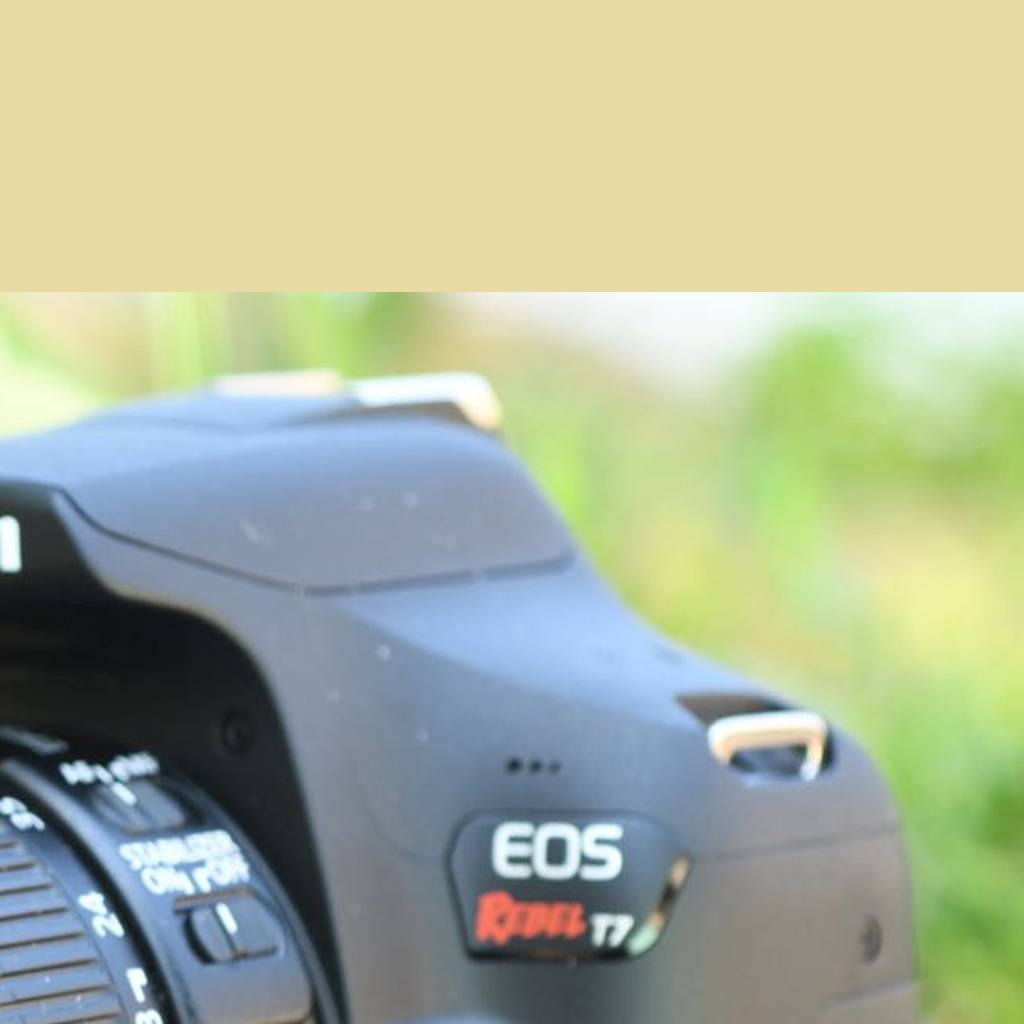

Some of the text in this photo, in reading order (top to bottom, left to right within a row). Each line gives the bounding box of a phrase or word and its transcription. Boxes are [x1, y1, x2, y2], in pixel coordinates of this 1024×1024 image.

[492, 820, 624, 881] EOS
[78, 891, 124, 938] 24
[591, 912, 634, 947] T7
